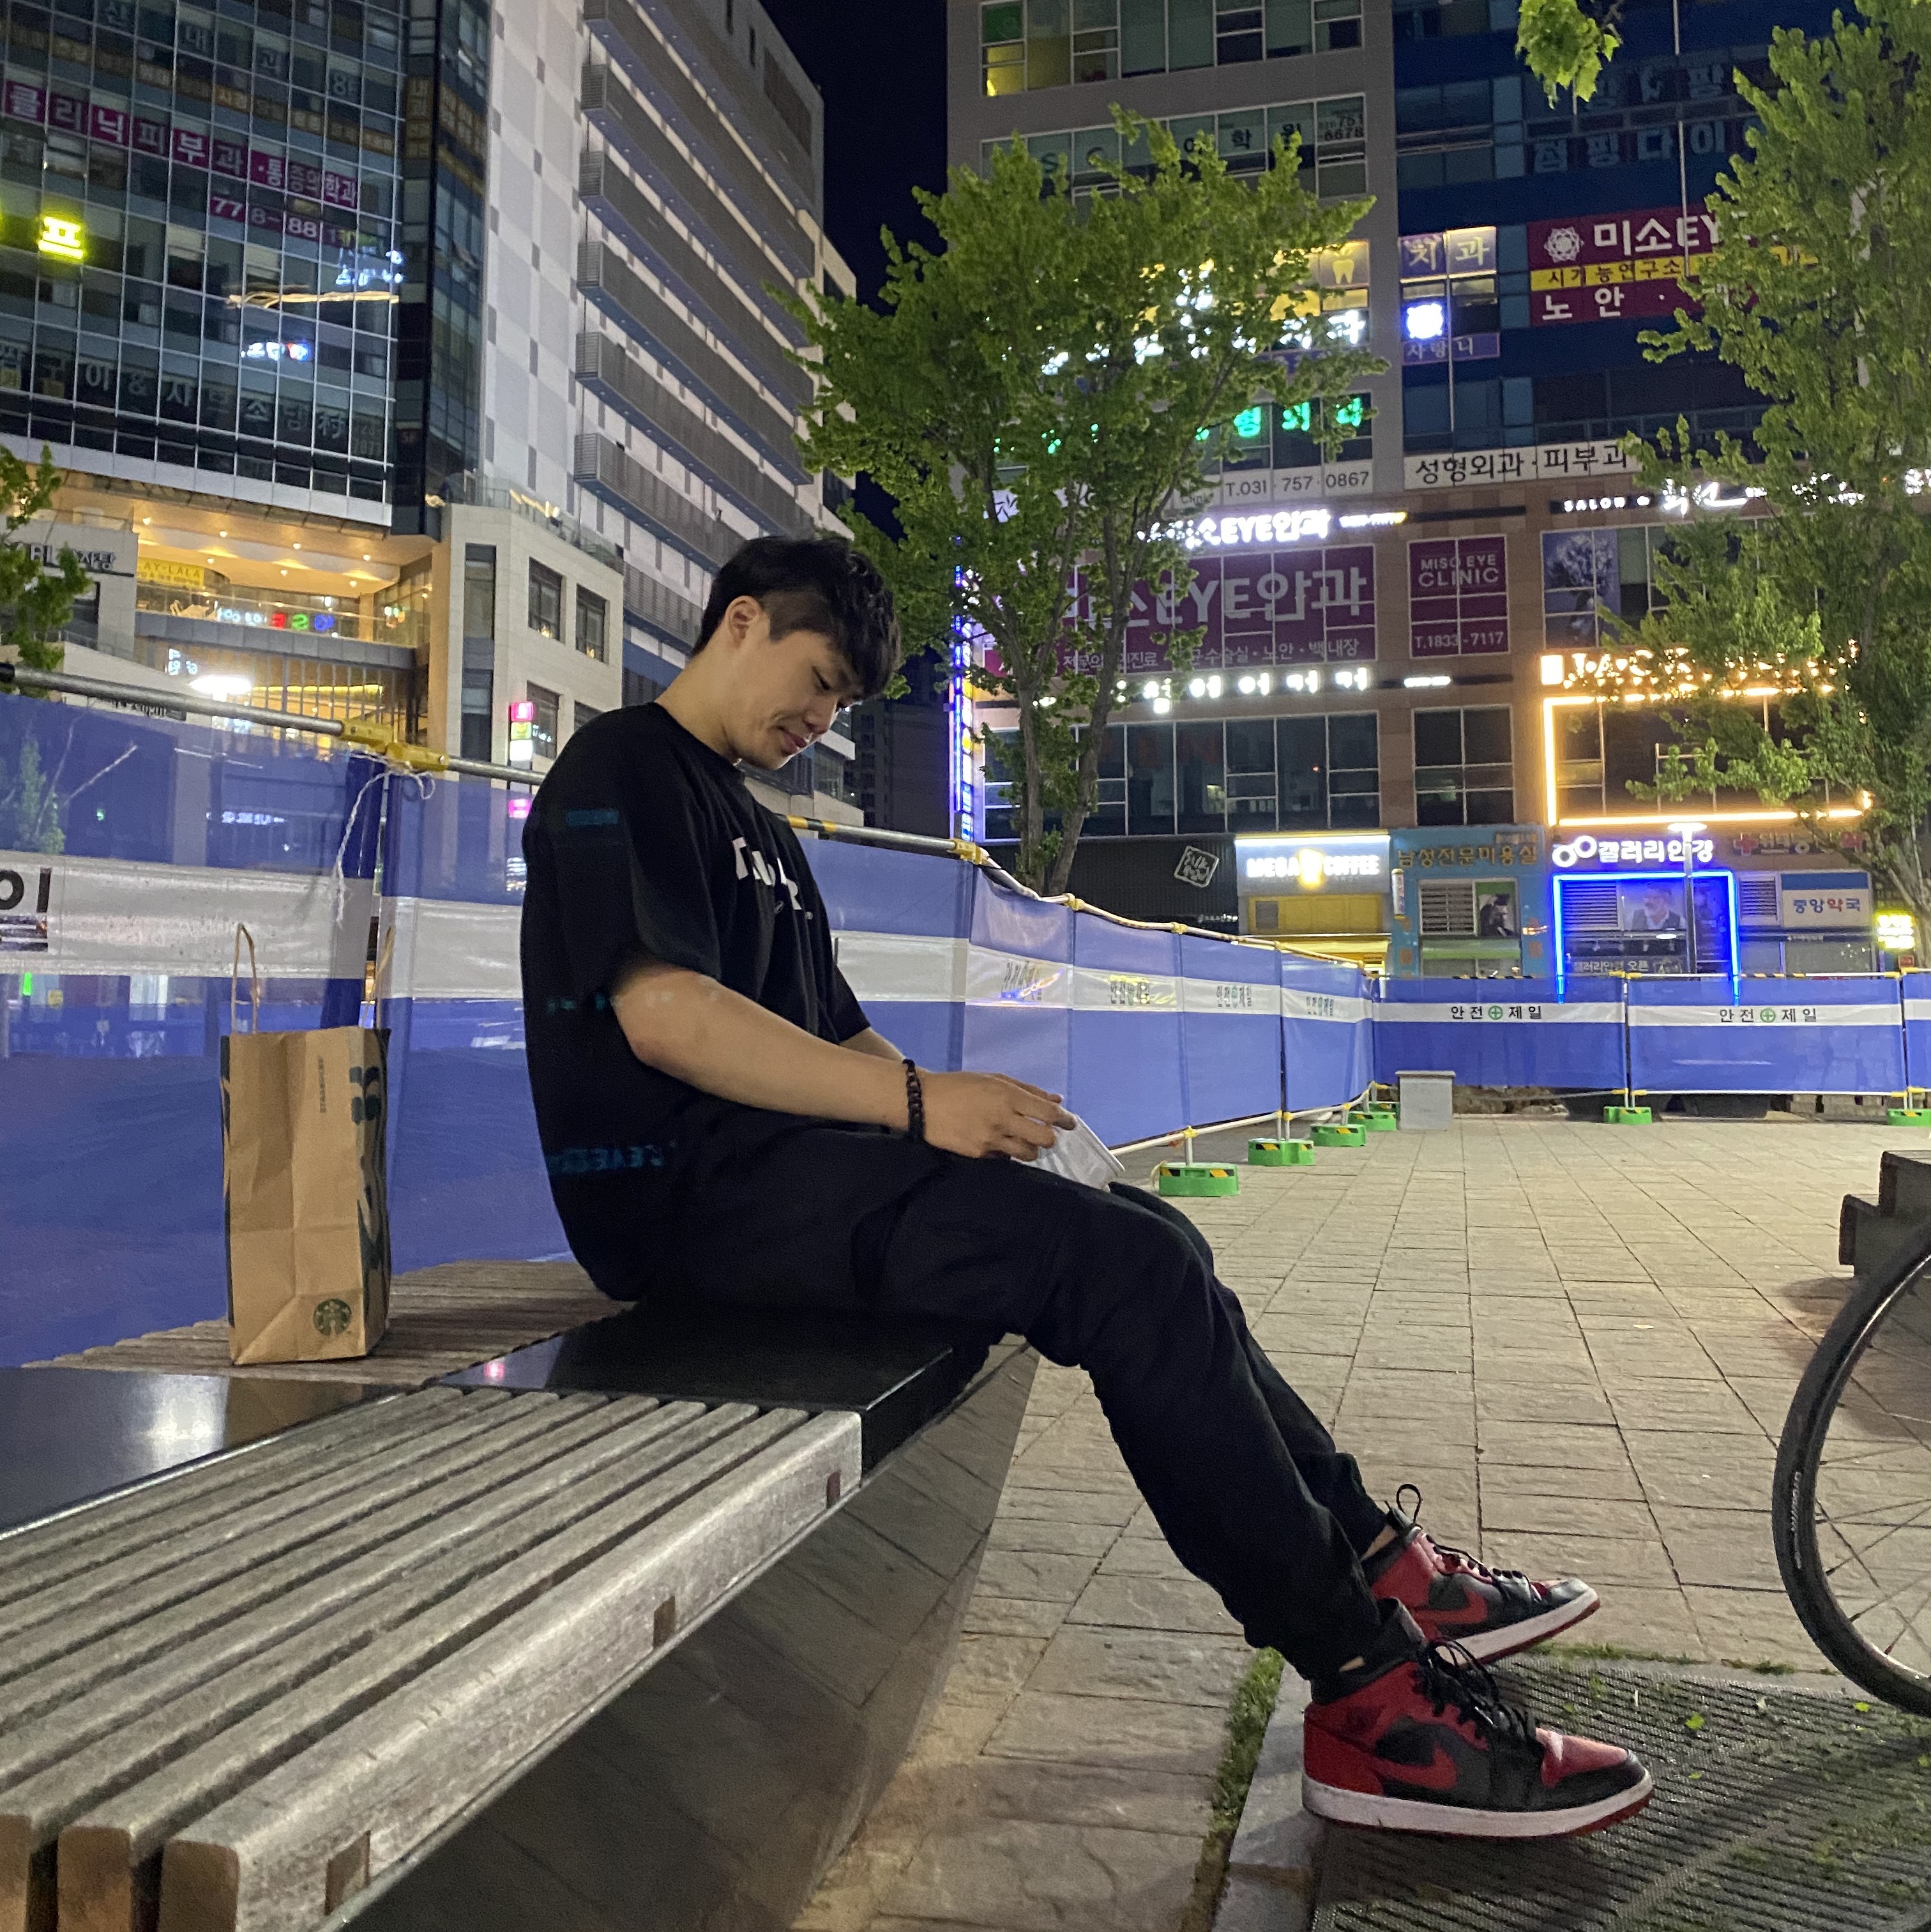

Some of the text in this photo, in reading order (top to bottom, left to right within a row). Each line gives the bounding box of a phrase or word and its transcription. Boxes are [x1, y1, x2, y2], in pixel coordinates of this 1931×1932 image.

[1403, 236, 1490, 270] 치과
[1548, 259, 1682, 284] 시기능연구소
[1415, 454, 1525, 484] 성형외과
[1282, 476, 1313, 492] 757
[1326, 472, 1370, 489] 0867
[1563, 496, 1626, 512] SALON
[1420, 554, 1497, 570] MISO EYE
[1418, 567, 1500, 588] CLINIC
[1261, 643, 1294, 661] 노안
[1309, 638, 1360, 658] 백내장
[1398, 844, 1539, 869] 남성전문미용실
[1598, 839, 1714, 863] 갤러리안경
[1323, 855, 1380, 876] COFFEE
[1792, 897, 1861, 913] 중앙약국
[1627, 959, 1649, 972] 오픈
[1450, 1005, 1542, 1020] 안전 제일
[1719, 1008, 1817, 1023] 안전 제일
